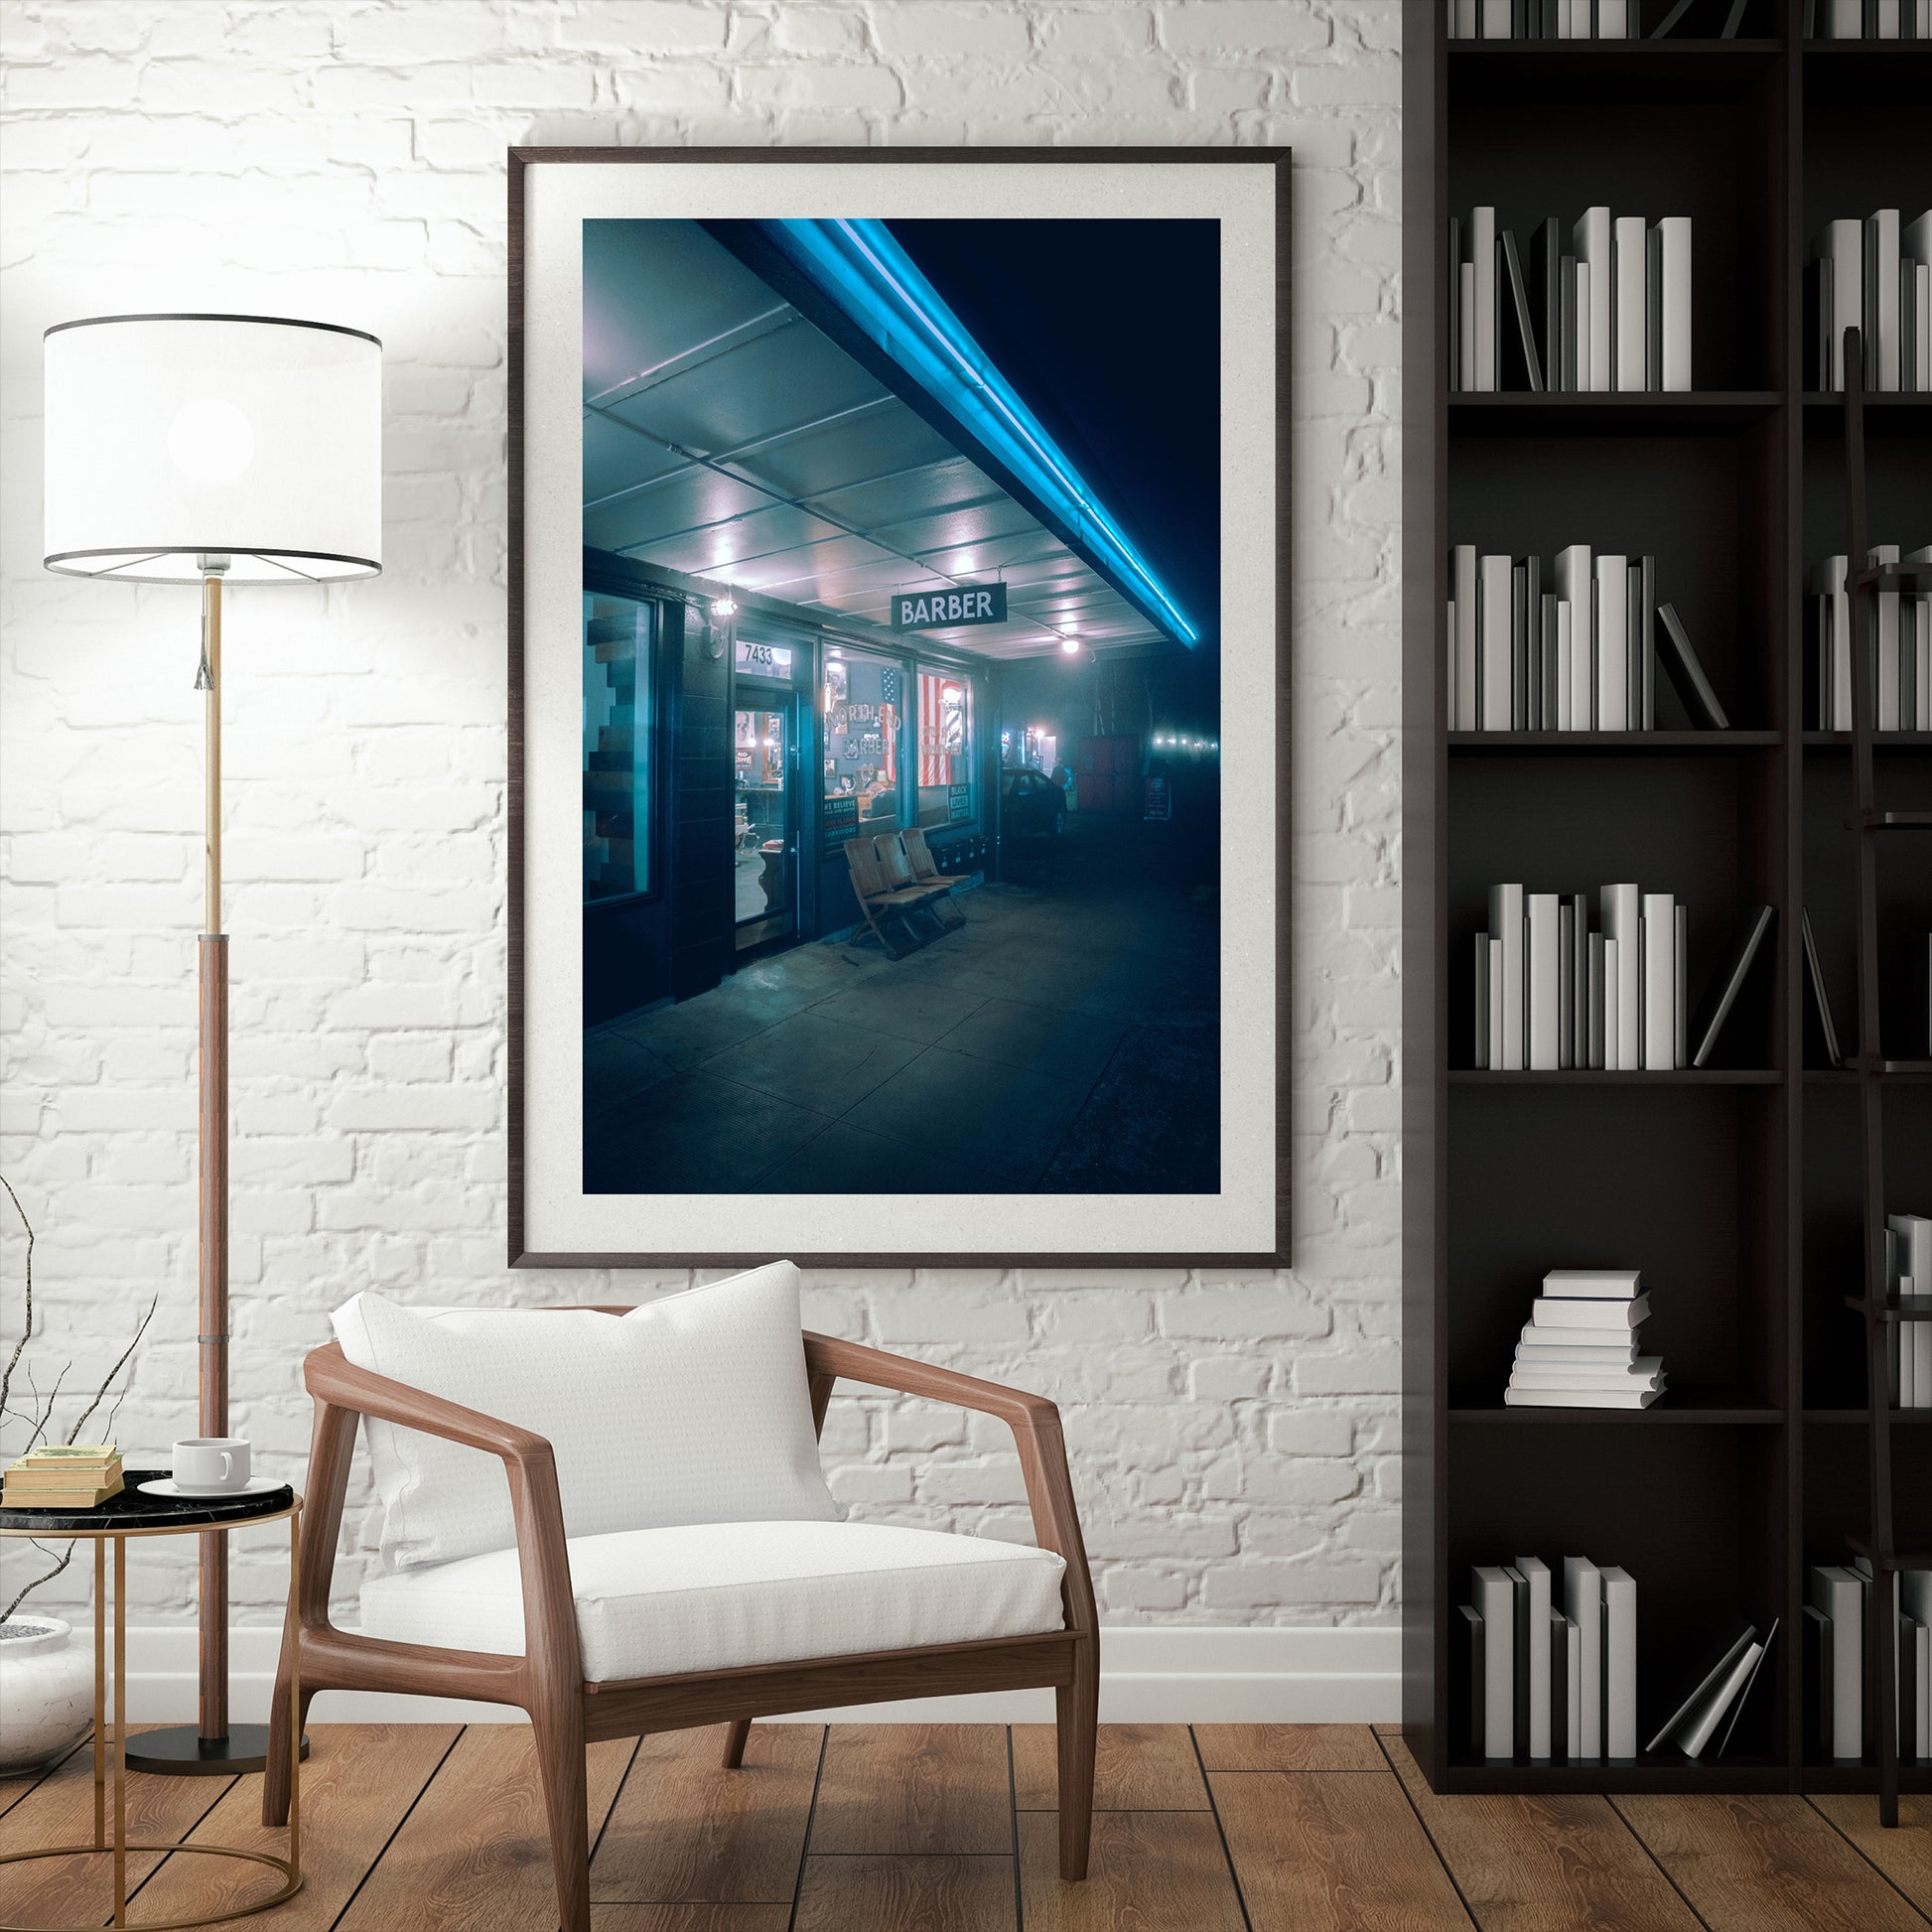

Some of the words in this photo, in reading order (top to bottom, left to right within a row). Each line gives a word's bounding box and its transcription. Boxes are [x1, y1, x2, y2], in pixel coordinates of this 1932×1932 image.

[901, 591, 994, 625] BARBER
[746, 643, 772, 665] 7433
[826, 705, 874, 731] NORTH
[878, 706, 901, 731] END
[843, 738, 891, 756] BARBER
[951, 785, 968, 795] BLACK
[833, 799, 856, 809] BELIEVE
[952, 797, 968, 807] LIVES
